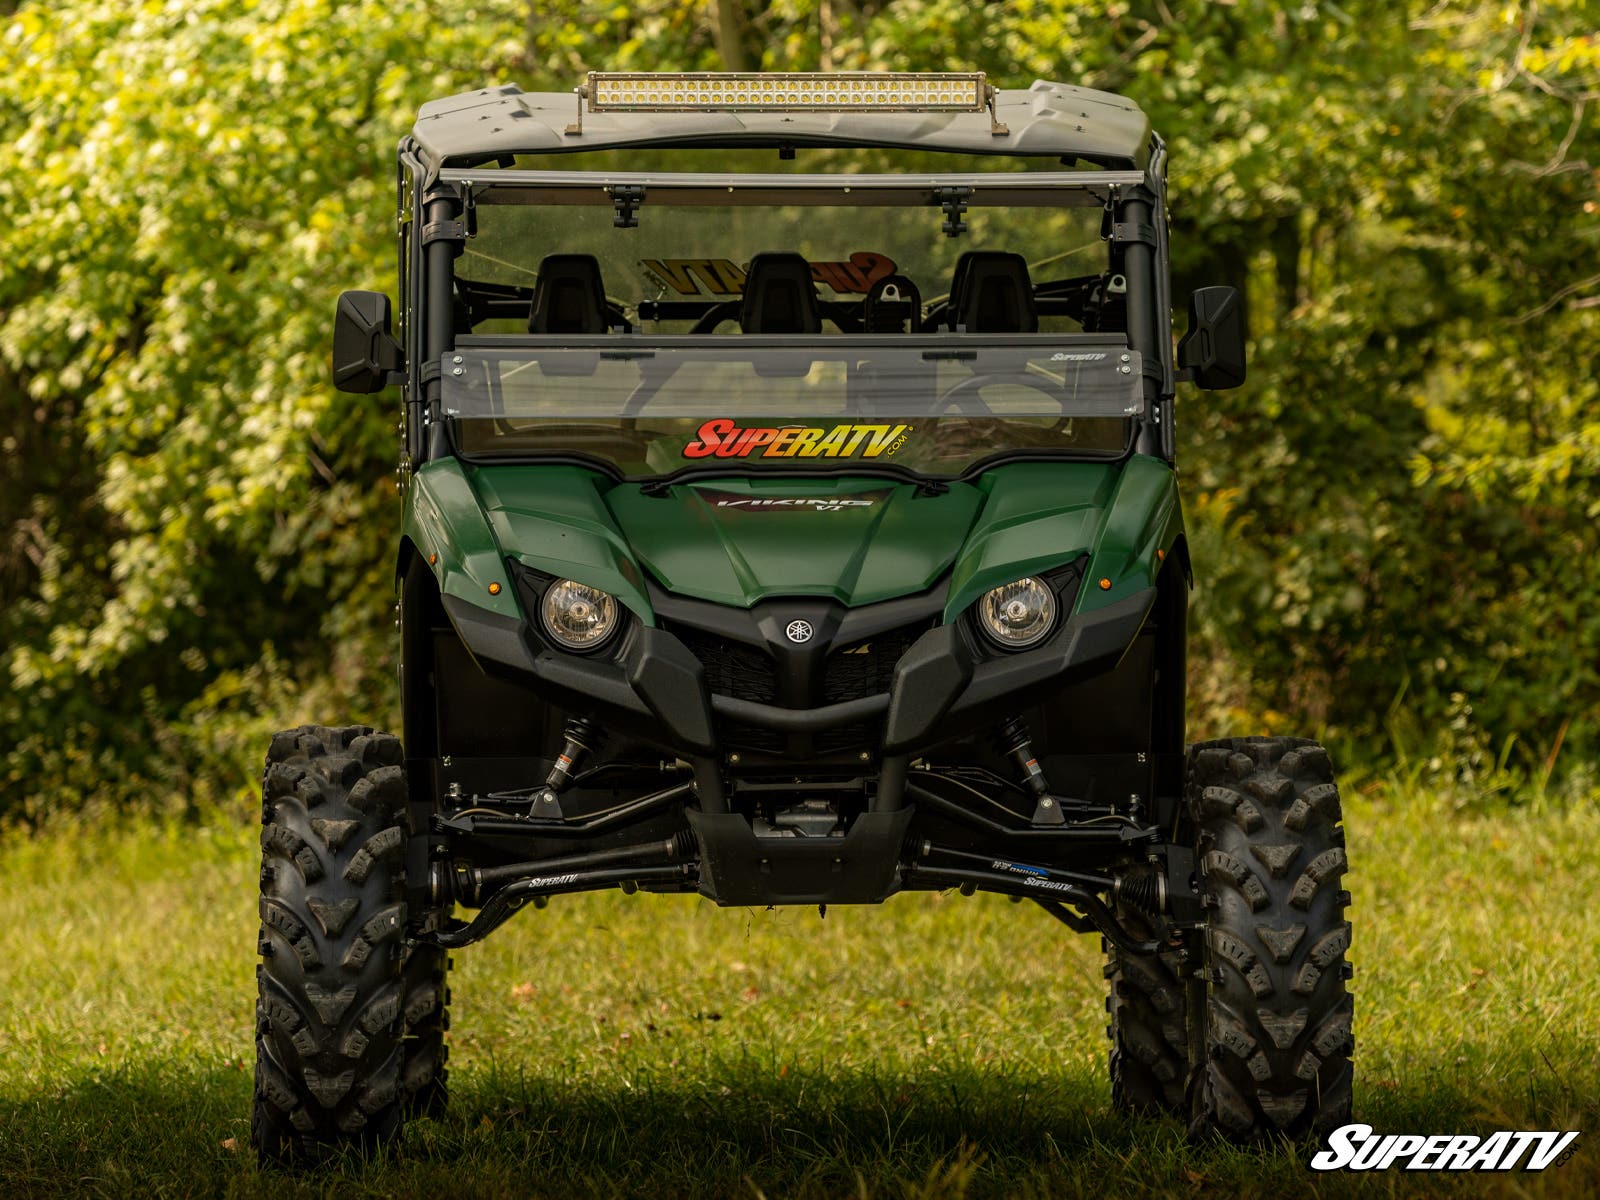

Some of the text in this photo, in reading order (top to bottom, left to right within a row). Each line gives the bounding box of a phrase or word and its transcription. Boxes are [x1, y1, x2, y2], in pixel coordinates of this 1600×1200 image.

[683, 418, 908, 459] SUPERATV
[717, 499, 874, 507] VIKING
[528, 873, 578, 888] SUPERATV
[1023, 876, 1073, 891] SUPERATV
